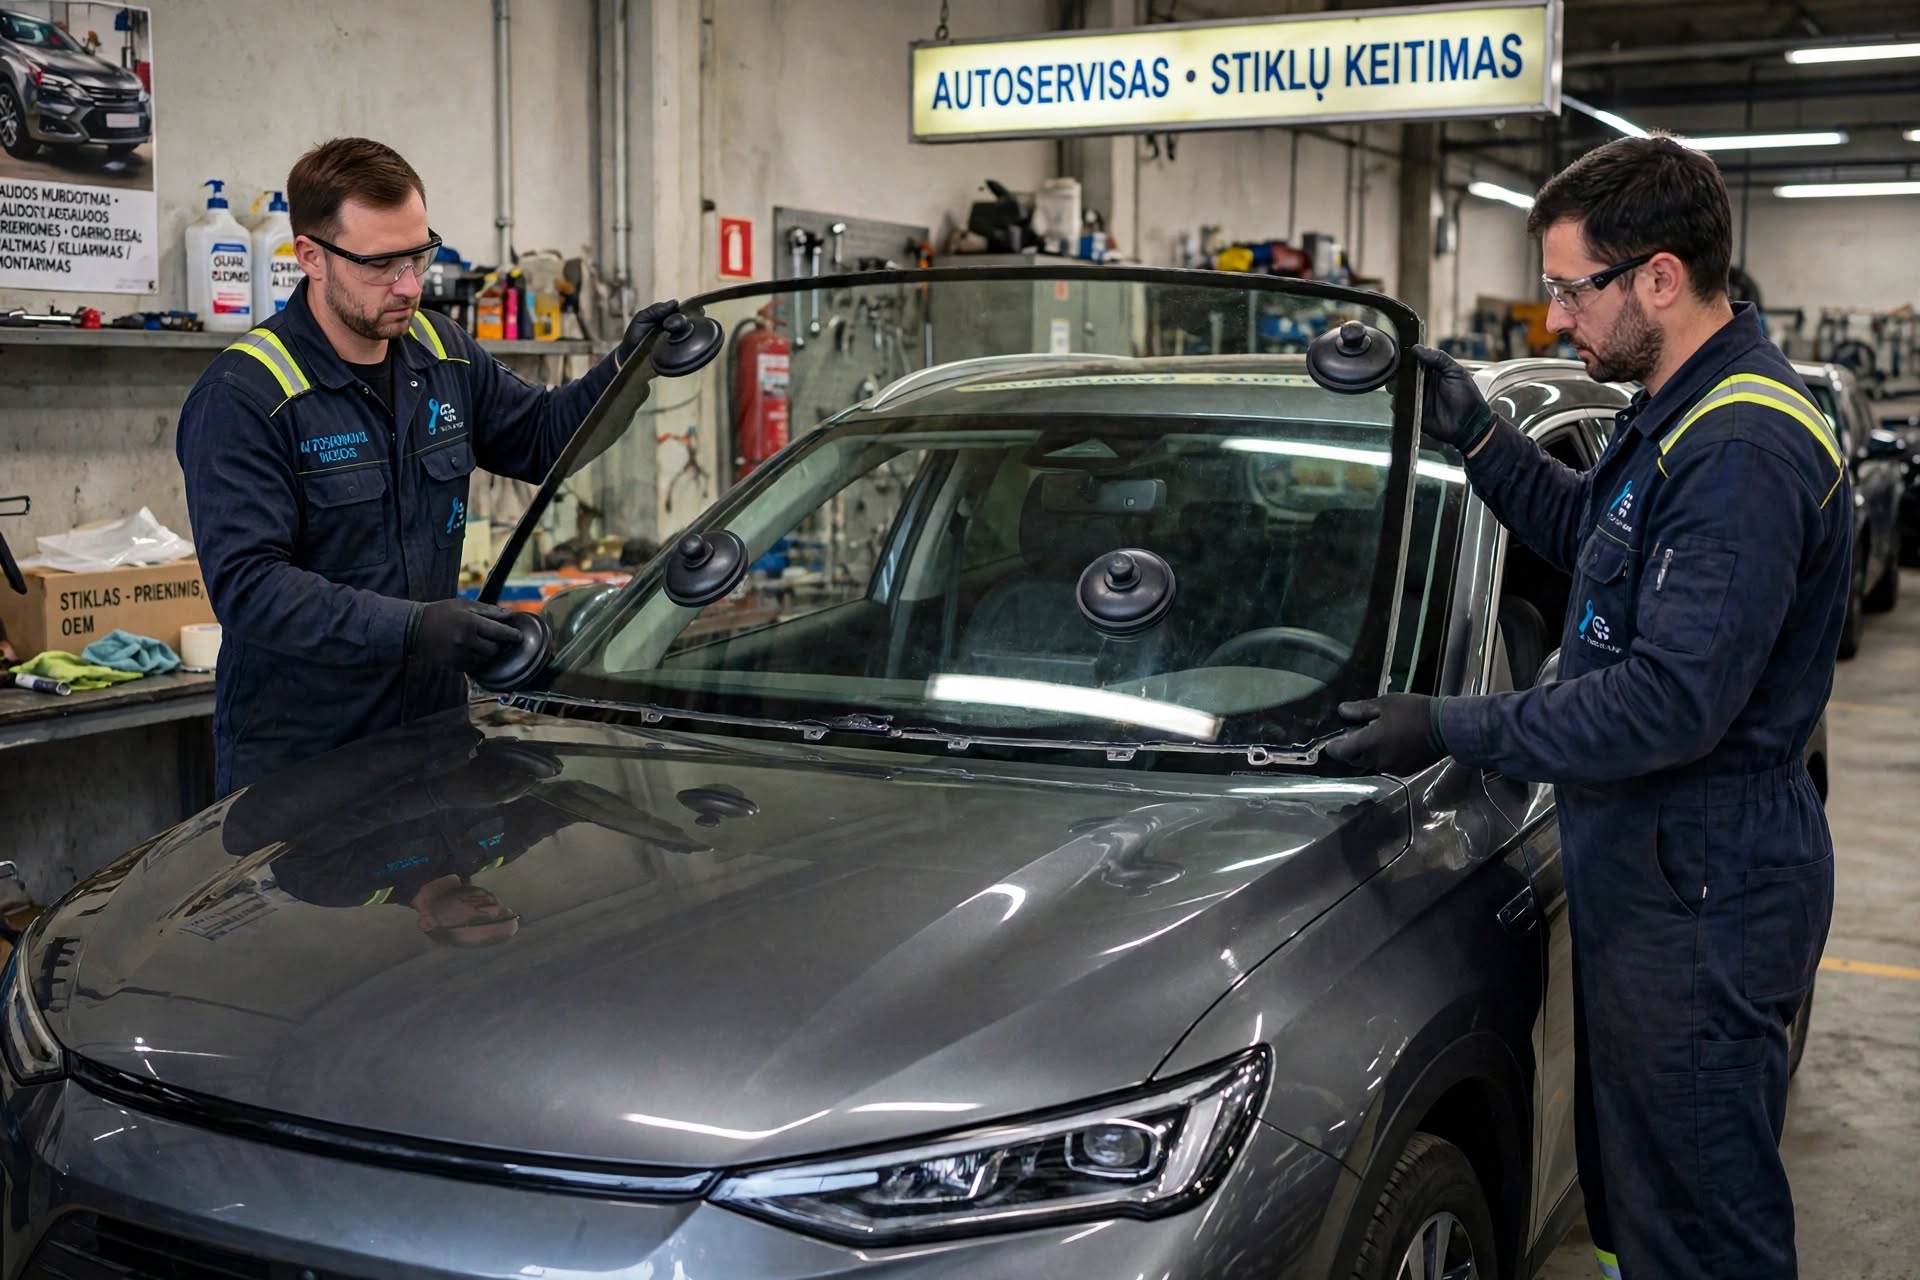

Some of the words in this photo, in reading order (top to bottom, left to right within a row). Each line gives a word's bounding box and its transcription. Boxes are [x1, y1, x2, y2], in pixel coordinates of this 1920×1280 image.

[932, 57, 1170, 110] AUTOSERVISAS
[1211, 48, 1330, 100] STIKLŲ
[1345, 33, 1523, 86] KEITIMAS
[0, 238, 46, 254] ALTMAS
[60, 587, 121, 611] STIKLAS
[62, 615, 94, 636] OEM
